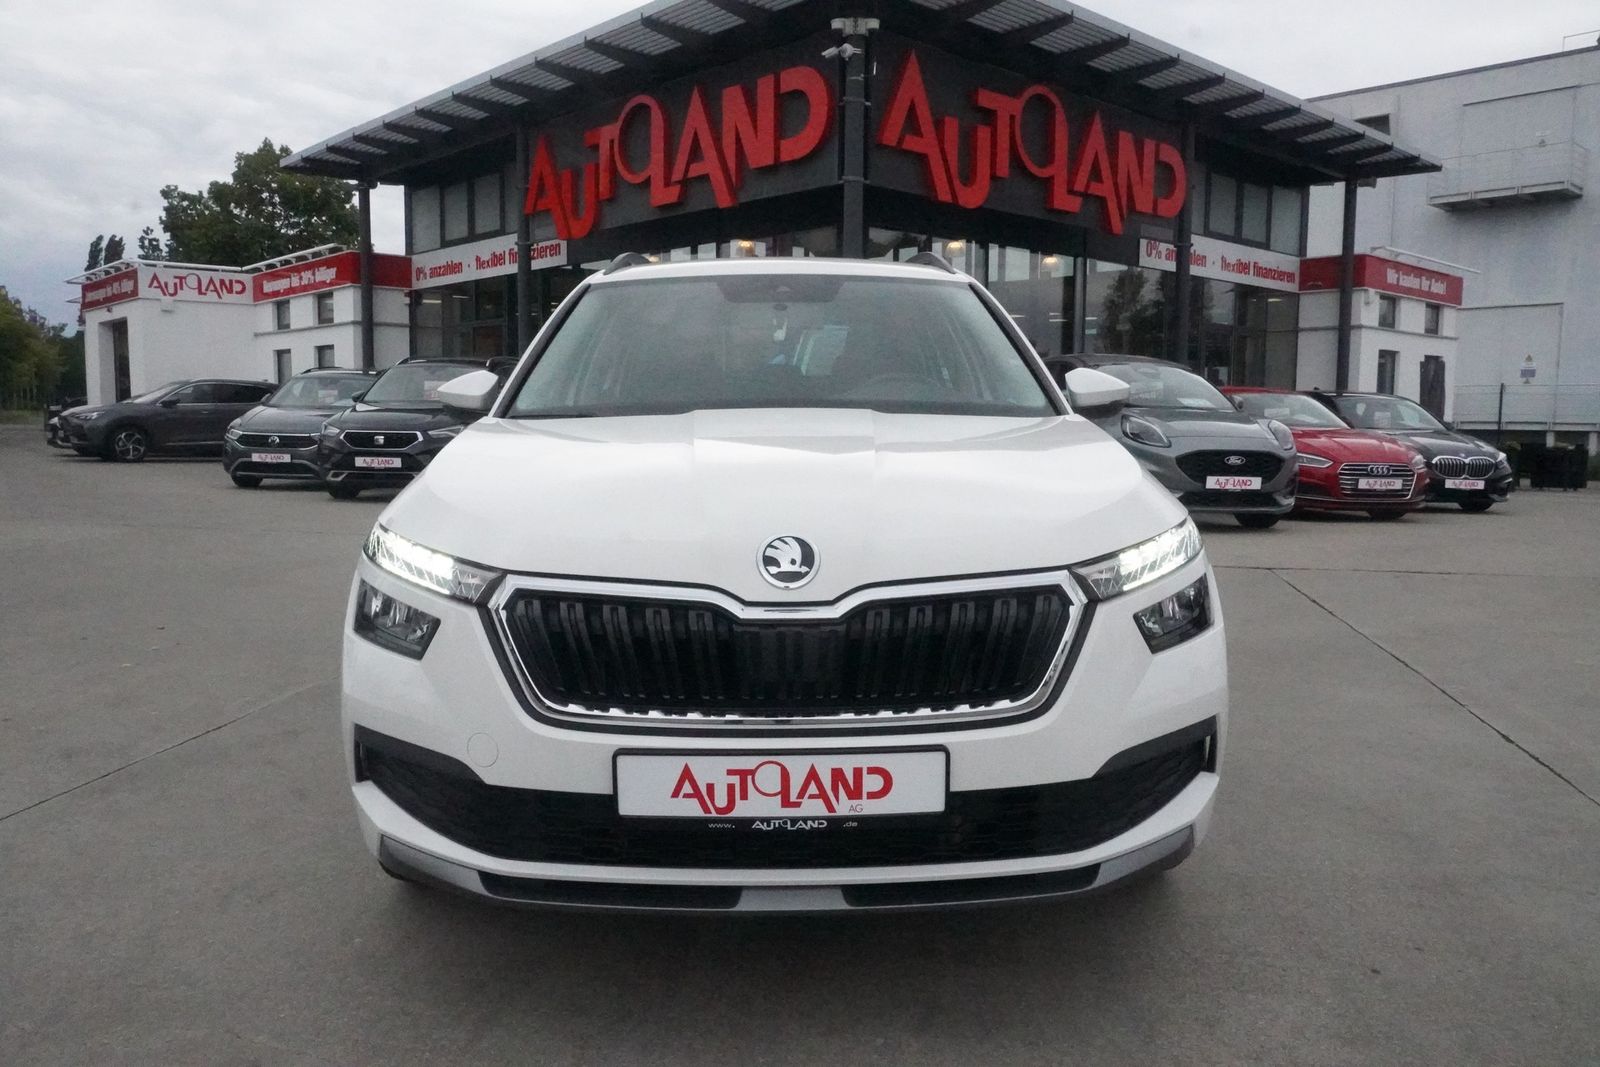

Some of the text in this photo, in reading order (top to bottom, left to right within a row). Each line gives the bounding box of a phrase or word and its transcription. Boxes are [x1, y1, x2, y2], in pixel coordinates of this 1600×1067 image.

[523, 65, 829, 240] AUTOLAND
[877, 49, 1187, 235] AUTOLAND
[415, 242, 561, 281] 0% anzahlen flexibel finzieren
[1145, 240, 1296, 283] 0% anlen flexibel finanzieren
[148, 272, 247, 299] AUTOLAND
[670, 760, 894, 815] AUTOLAND
[848, 803, 864, 813] AG
